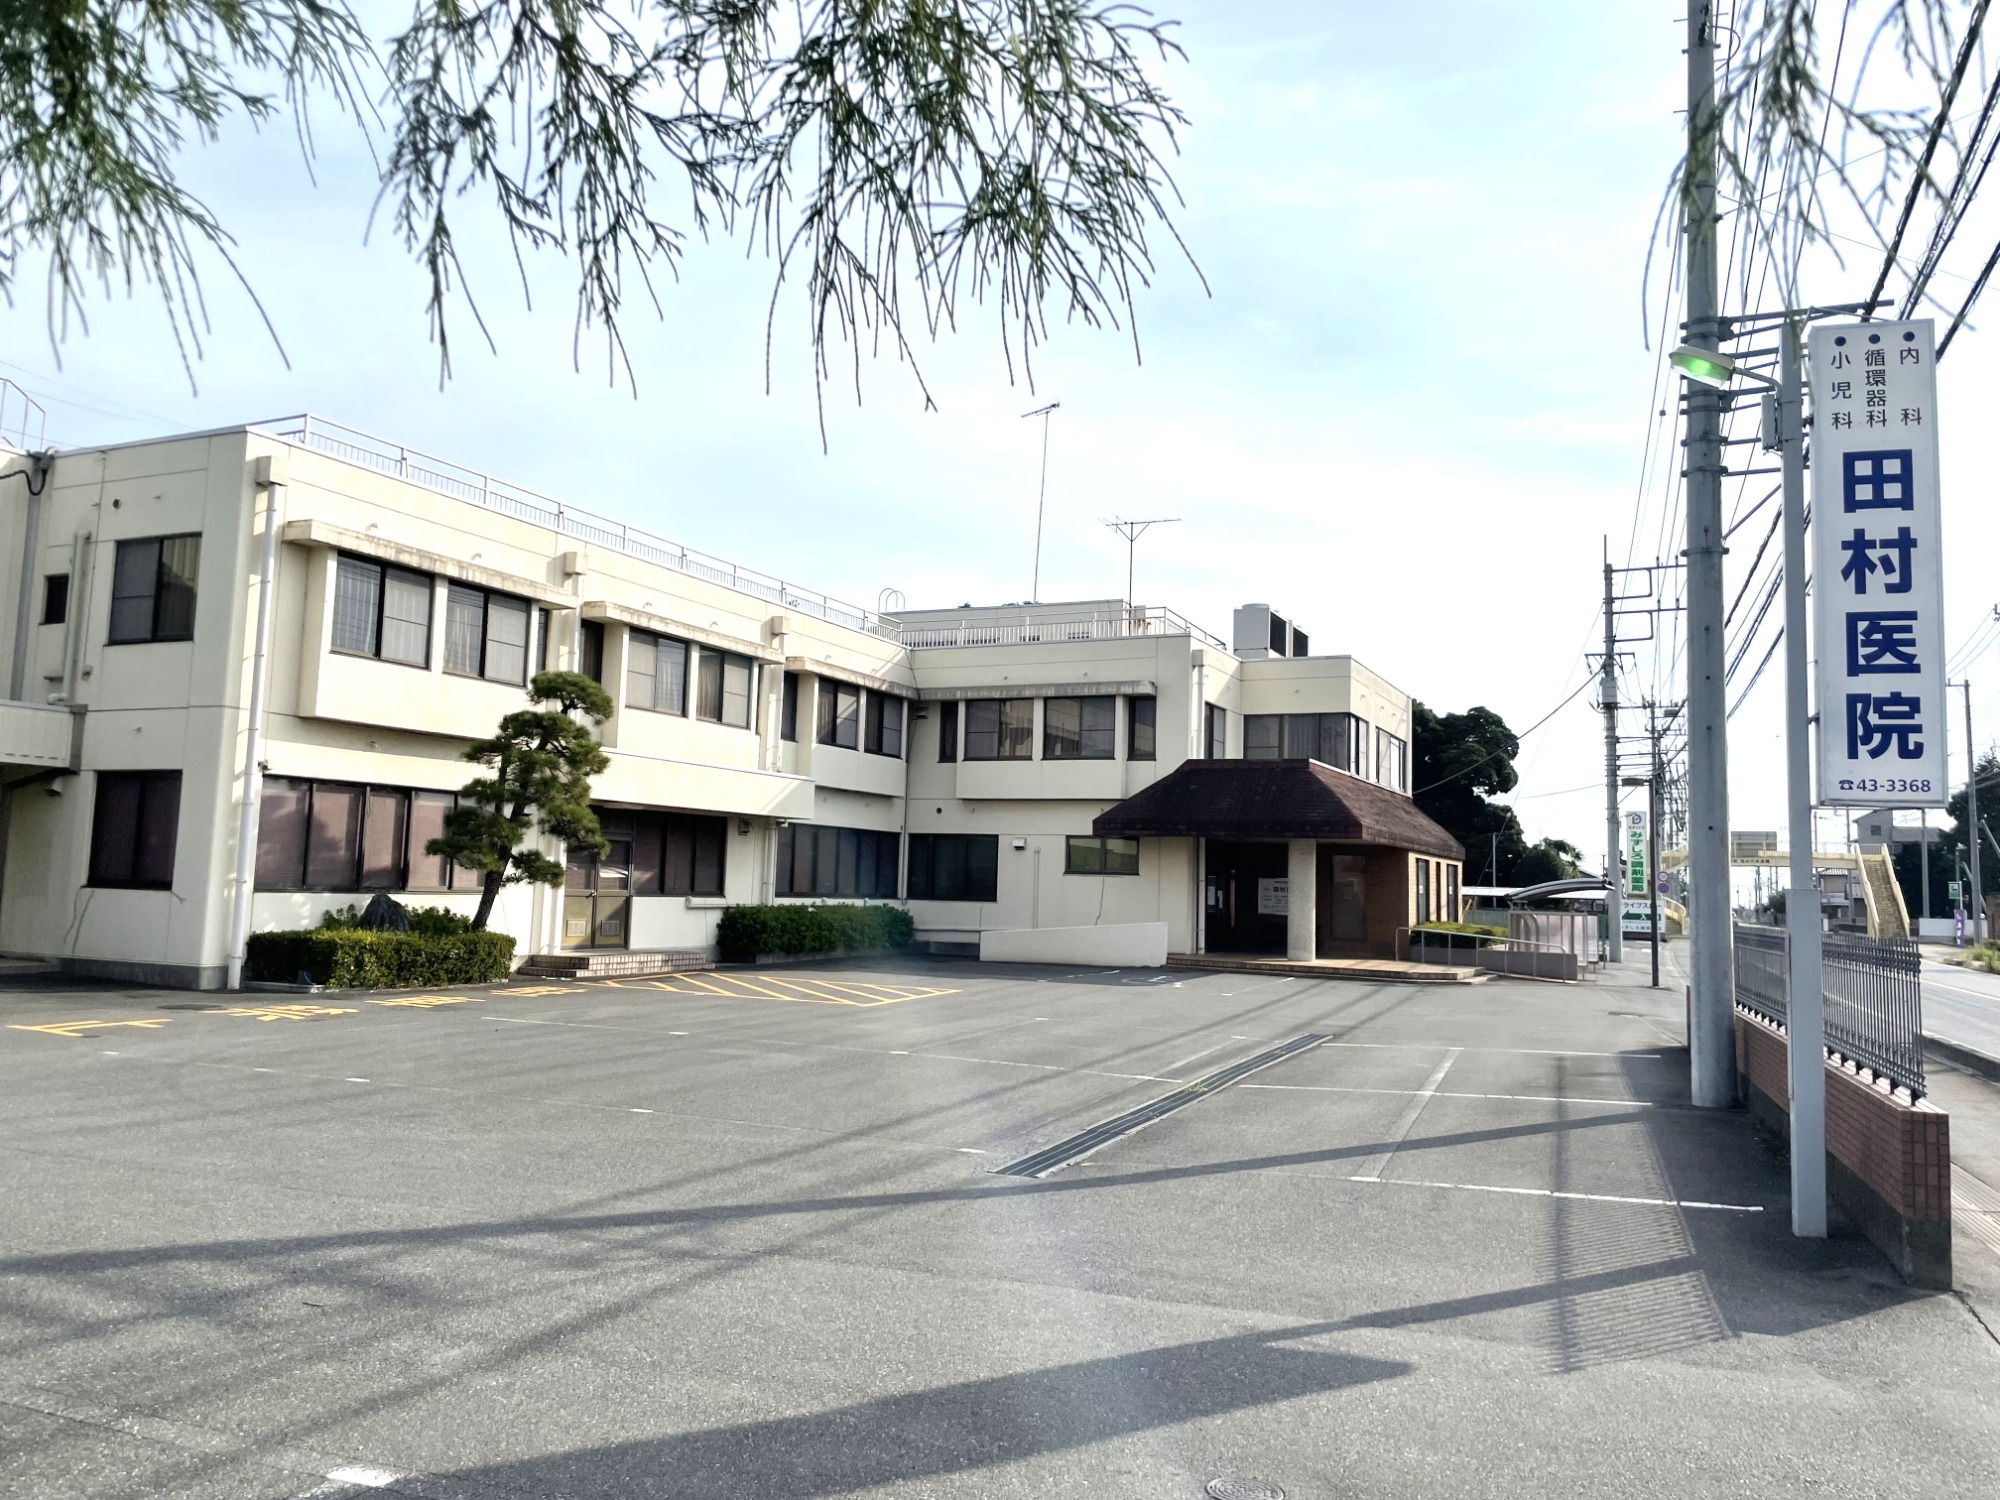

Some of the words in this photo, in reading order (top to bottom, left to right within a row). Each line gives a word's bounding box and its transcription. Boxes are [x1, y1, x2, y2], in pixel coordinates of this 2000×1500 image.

[1830, 351, 1853, 430] 小児科
[1864, 348, 1888, 428] 循環器科
[1900, 346, 1923, 427] 内科
[1840, 448, 1925, 760] 田村医院
